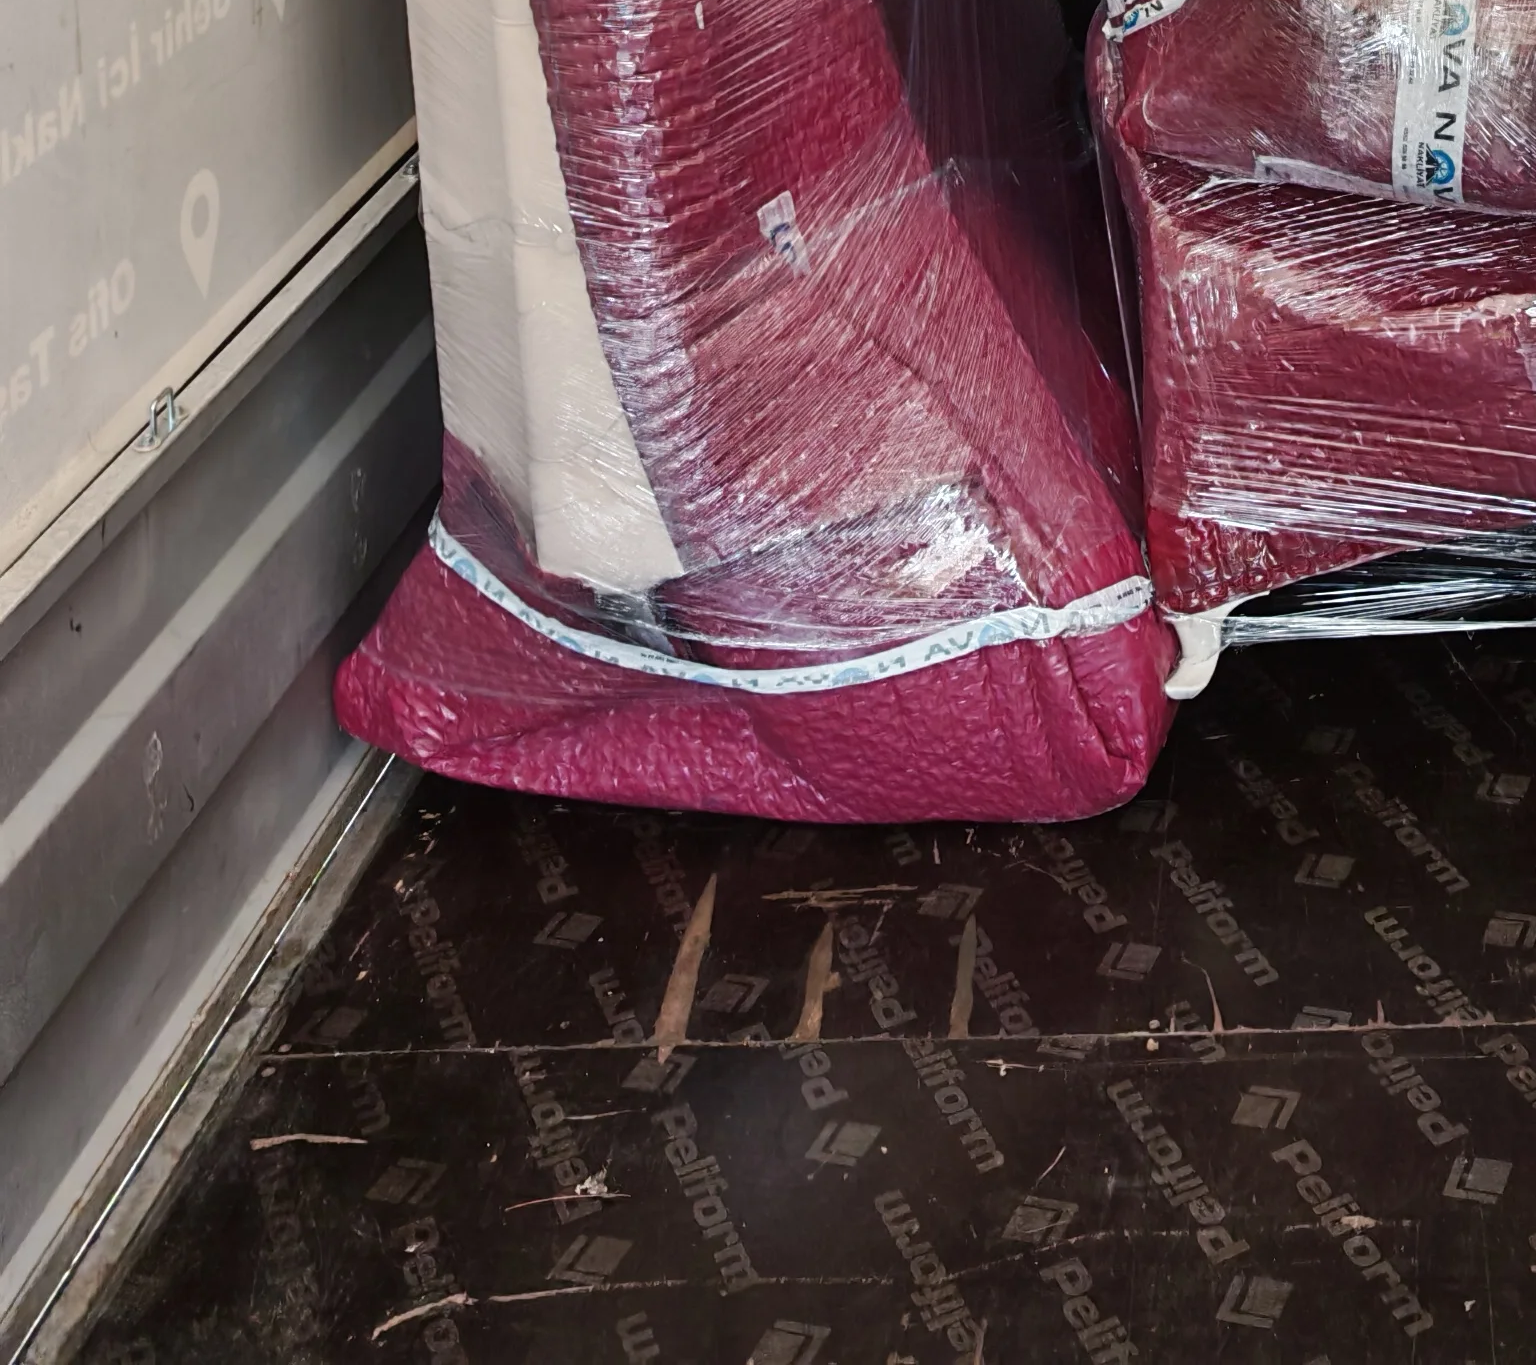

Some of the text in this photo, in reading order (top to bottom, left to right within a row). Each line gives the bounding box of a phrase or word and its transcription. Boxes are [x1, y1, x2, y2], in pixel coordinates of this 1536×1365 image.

[1150, 839, 1279, 987] Peliform
[652, 1101, 759, 1297] Peliform
[1107, 1078, 1250, 1268] Peliform
